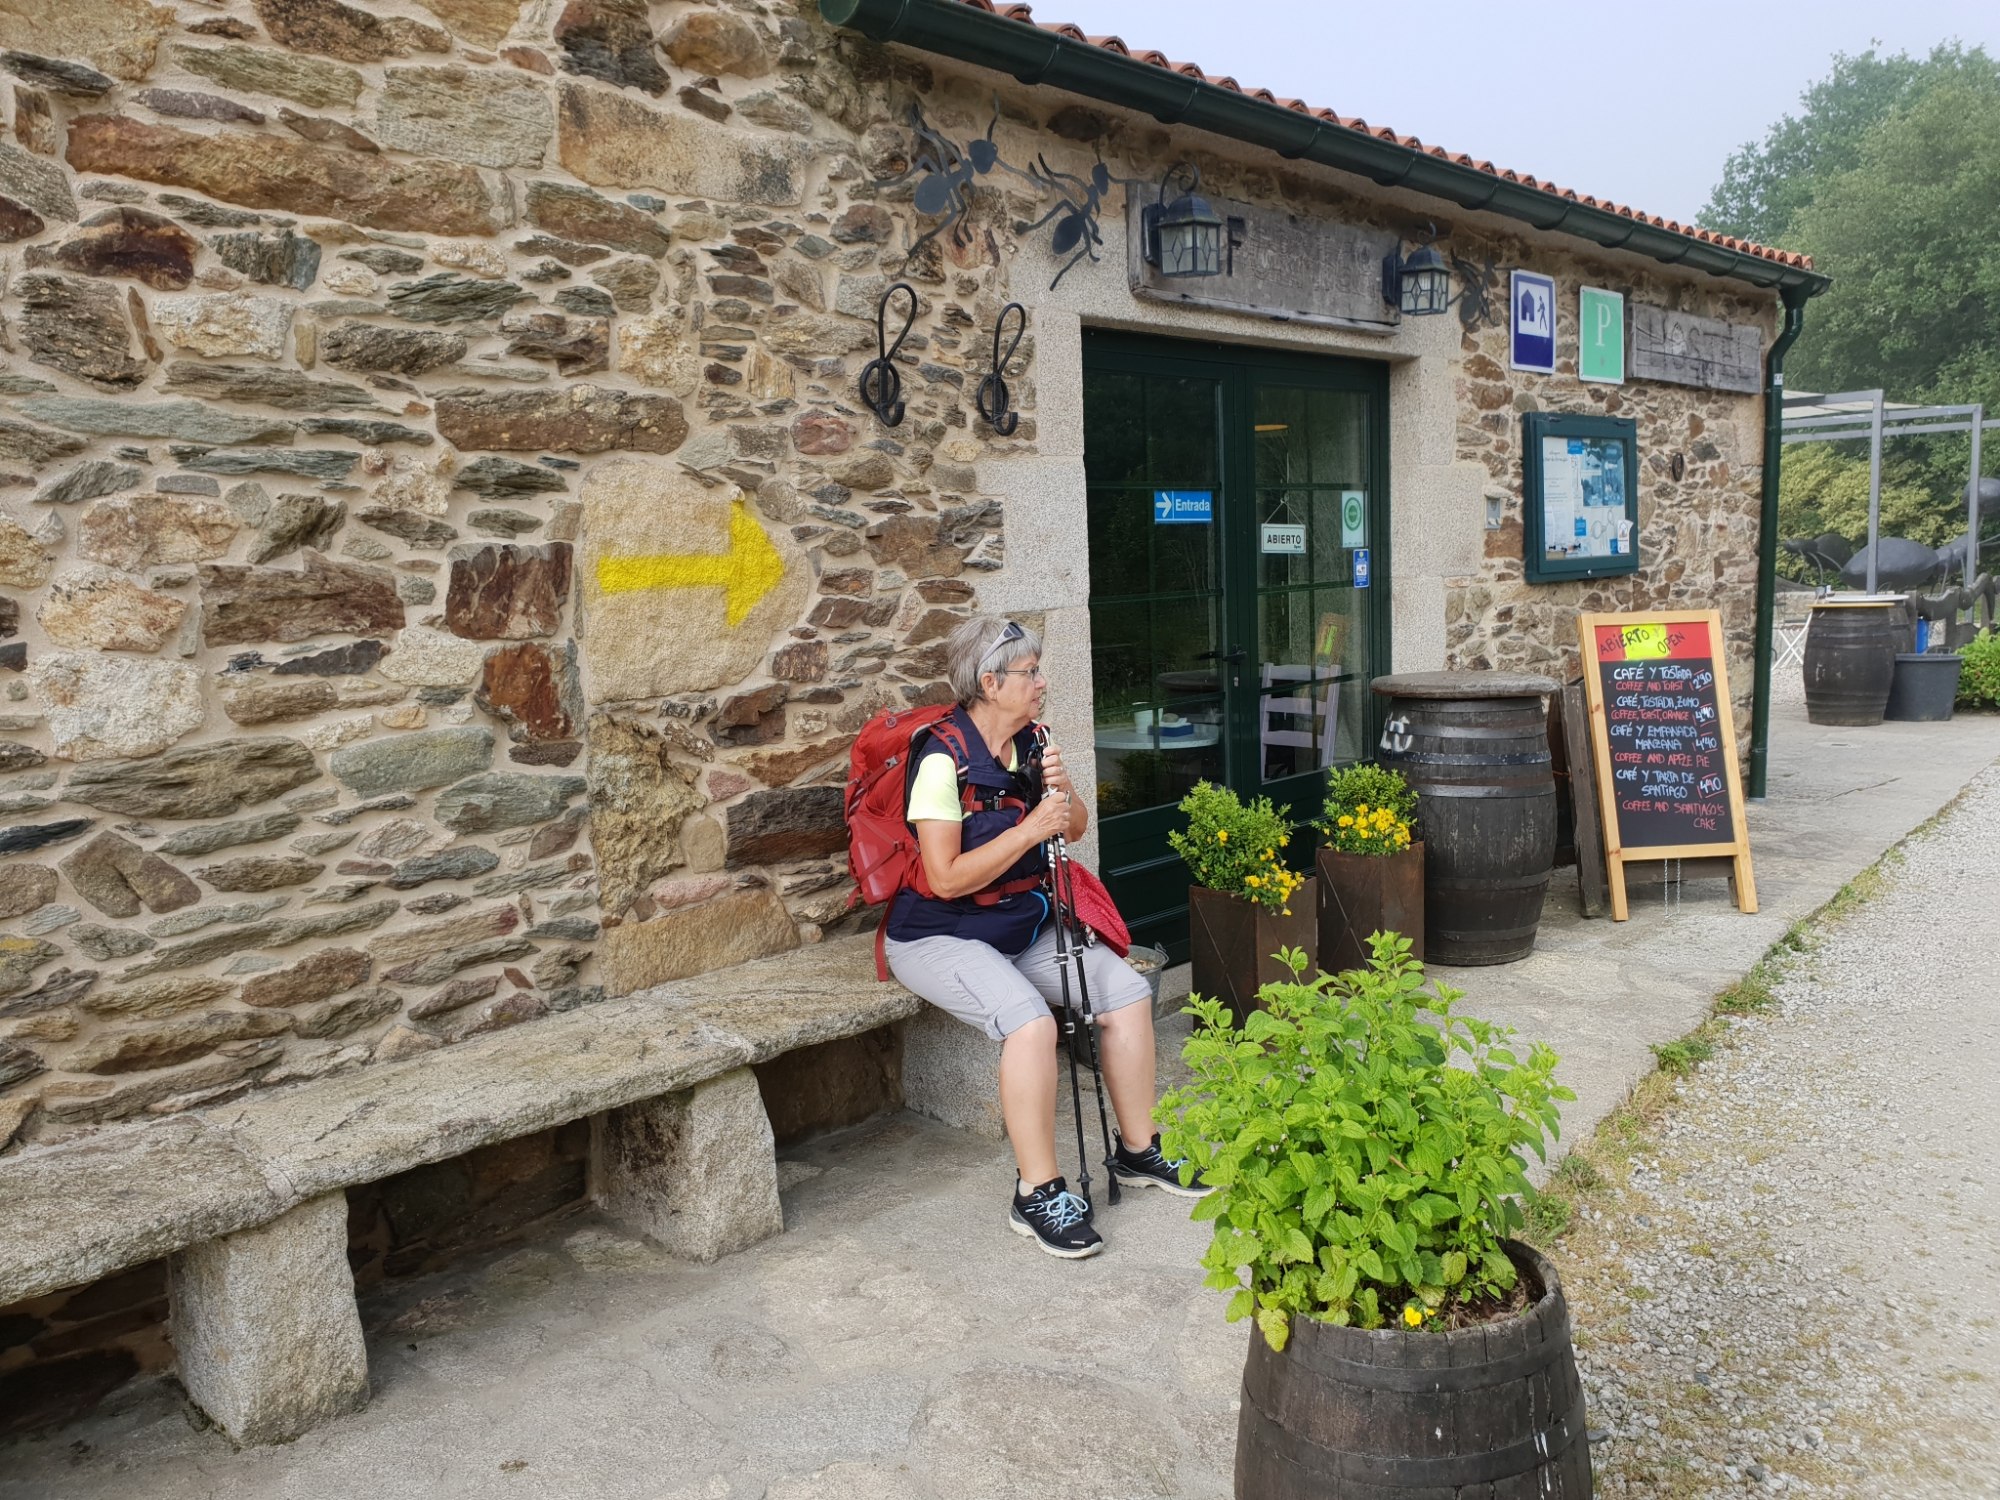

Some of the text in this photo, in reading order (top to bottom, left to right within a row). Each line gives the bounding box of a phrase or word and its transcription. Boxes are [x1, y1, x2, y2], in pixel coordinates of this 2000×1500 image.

[1595, 303, 1611, 346] P
[1175, 499, 1210, 512] Entrada
[1267, 534, 1302, 545] ABIERTO
[1600, 627, 1650, 655] ABIERTO
[1657, 632, 1685, 654] OPEN
[1613, 662, 1692, 680] CAFÉ Y TOSTADA
[1616, 681, 1684, 691] COFFEE AND TOAST
[1677, 696, 1700, 708] ZUMO
[1662, 710, 1690, 721] ORANGE
[1610, 722, 1697, 738] CAFÉ Y EMPANADA
[1635, 739, 1682, 751] MANZANA
[1615, 752, 1711, 768] COFFEE AND APPLE PIE
[1616, 766, 1695, 784] CAFÉ Y TARTA DE
[1641, 784, 1688, 799] SANTIAGO
[1622, 800, 1651, 811] COFFEE
[1654, 801, 1669, 812] AND
[1693, 817, 1717, 831] CAKE
